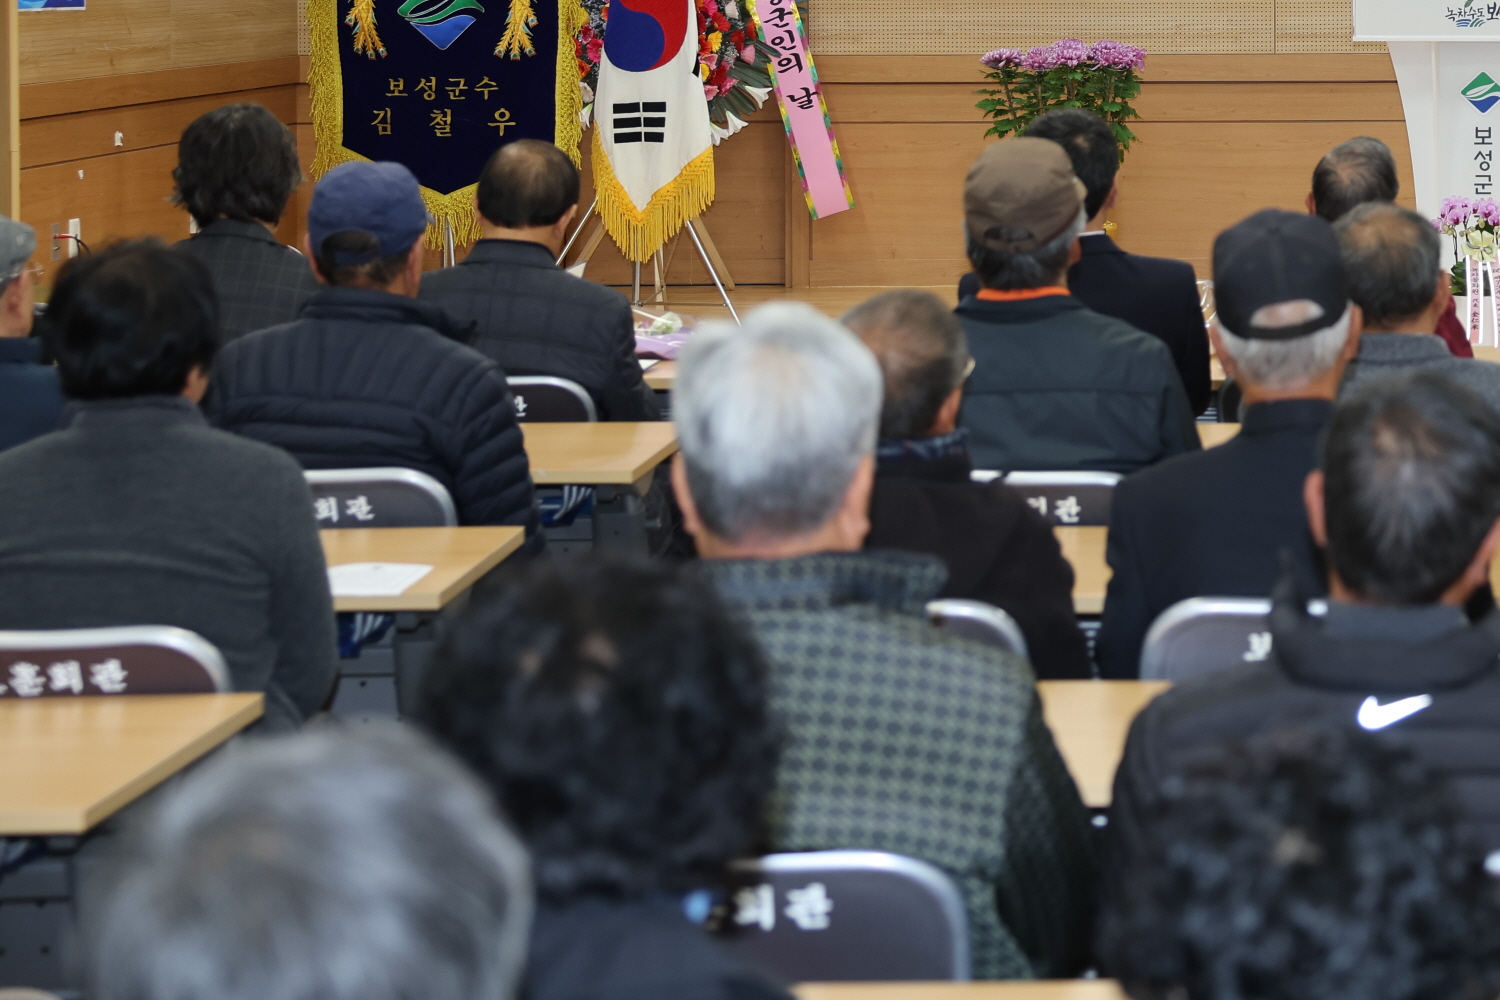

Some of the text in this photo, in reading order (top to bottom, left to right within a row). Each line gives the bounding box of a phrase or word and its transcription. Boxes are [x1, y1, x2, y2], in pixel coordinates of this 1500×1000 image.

[385, 76, 499, 101] 보성군수
[786, 86, 819, 110] 날
[371, 107, 516, 137] 김 철 우
[1474, 126, 1493, 195] 보성군
[314, 495, 376, 523] 회관
[0, 658, 129, 698] 훈회관
